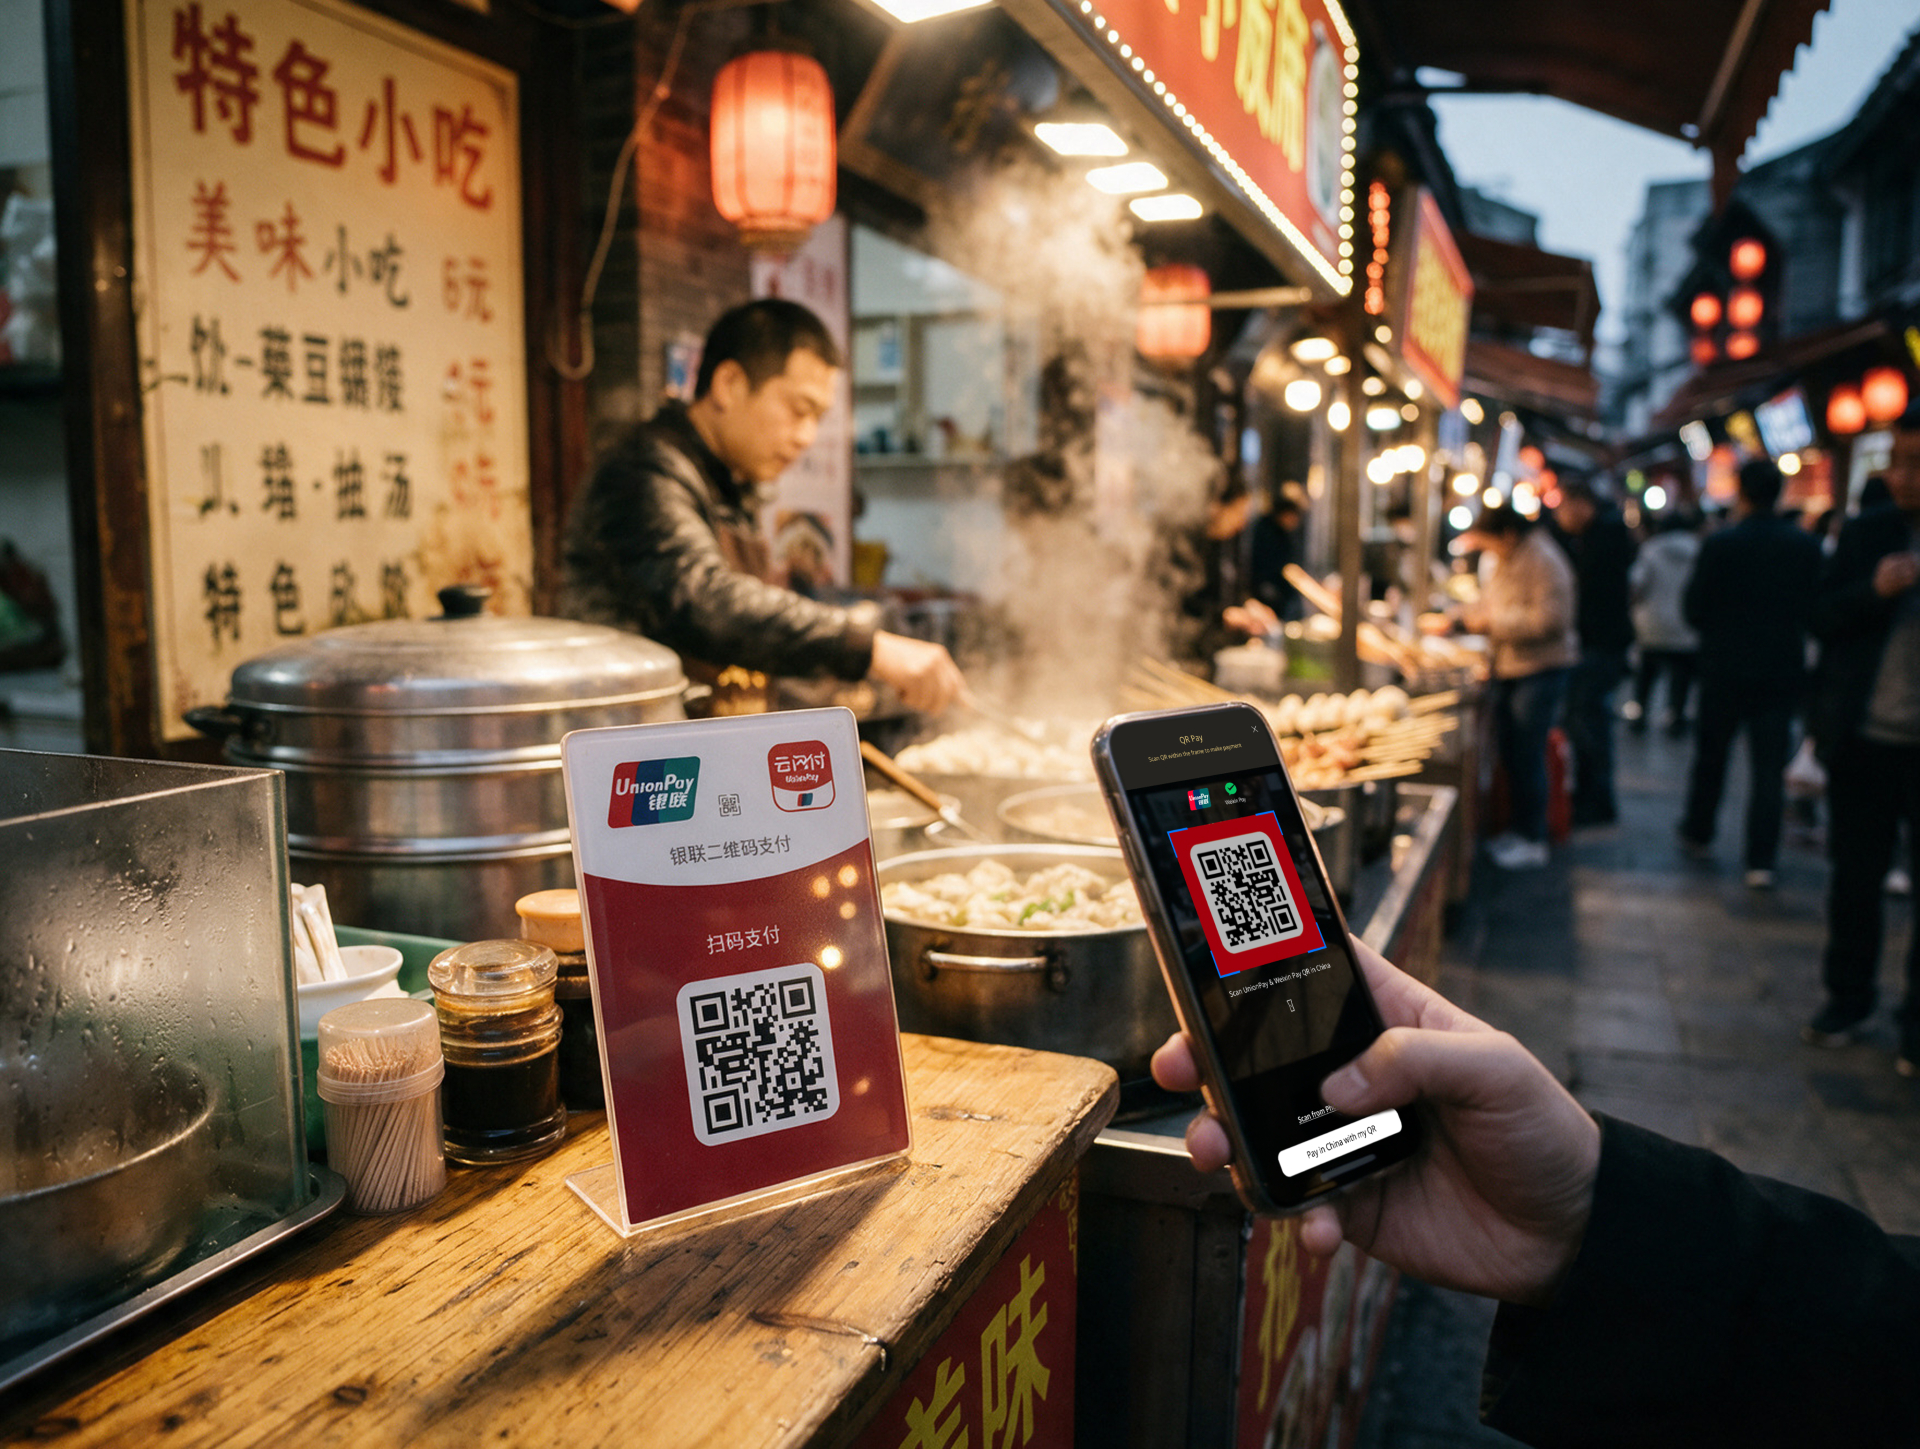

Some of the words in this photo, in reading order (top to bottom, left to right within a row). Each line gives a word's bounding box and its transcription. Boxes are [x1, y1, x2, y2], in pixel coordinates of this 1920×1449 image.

[172, 2, 494, 209] 特色小吃
[1179, 736, 1190, 745] QR
[1190, 735, 1203, 743] Pay
[616, 773, 694, 795] UnionPay
[648, 791, 688, 811] 银联
[669, 834, 791, 866] 银联二维码支付
[706, 924, 780, 955] 扫码支付
[1229, 988, 1243, 997] Scan
[1243, 981, 1268, 993] UnionPay
[1268, 978, 1274, 986] &
[1292, 971, 1302, 979] Pay
[1301, 968, 1311, 977] QR
[1310, 966, 1316, 974] in
[1316, 963, 1331, 972] China
[1298, 1113, 1312, 1123] Scan
[1311, 1108, 1325, 1118] from
[1306, 1149, 1318, 1159] Pay
[1318, 1146, 1326, 1154] in
[1325, 1139, 1344, 1151] China
[1343, 1132, 1357, 1144] with
[1357, 1130, 1366, 1139] my
[1366, 1124, 1377, 1135] QR
